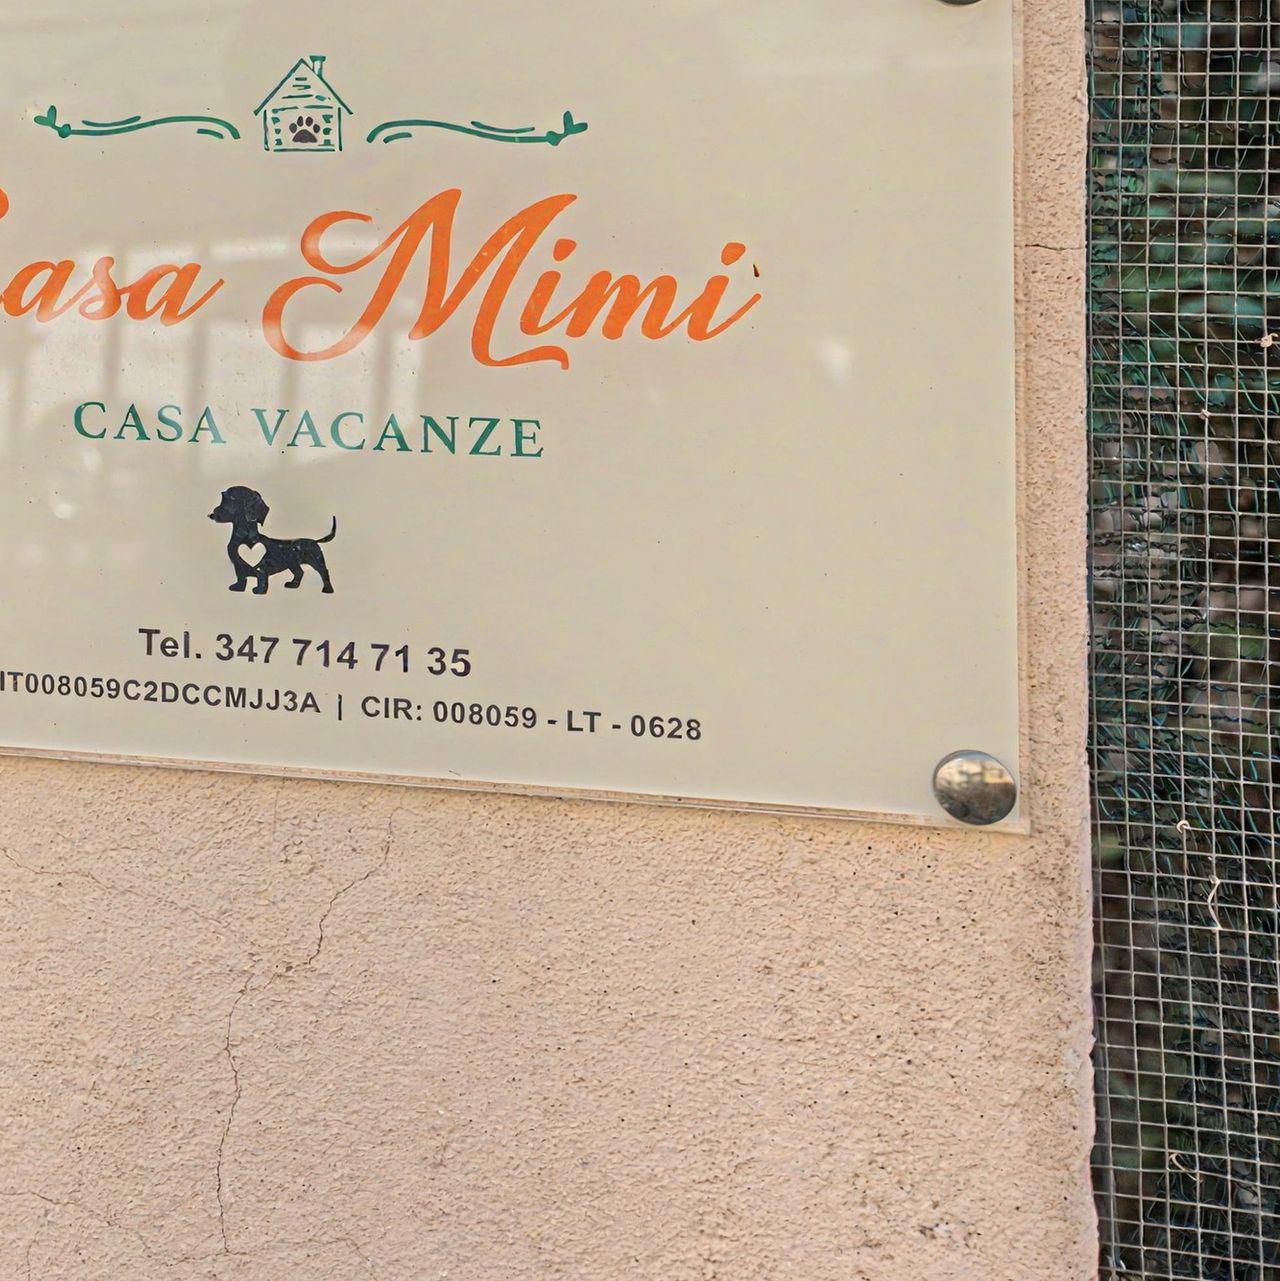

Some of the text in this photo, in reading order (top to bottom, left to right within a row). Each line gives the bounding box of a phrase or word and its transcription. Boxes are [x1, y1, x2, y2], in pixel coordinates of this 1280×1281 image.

[261, 187, 762, 371] Mimi
[74, 400, 544, 459] CASA VACANZE
[138, 627, 472, 677] Tel. 347 714 71 35
[0, 670, 321, 714] IT008059C2DCCMJJ3A
[360, 695, 422, 721] CIR:
[432, 700, 537, 729] 008059
[566, 709, 602, 733] LT
[630, 714, 702, 741] 0628
